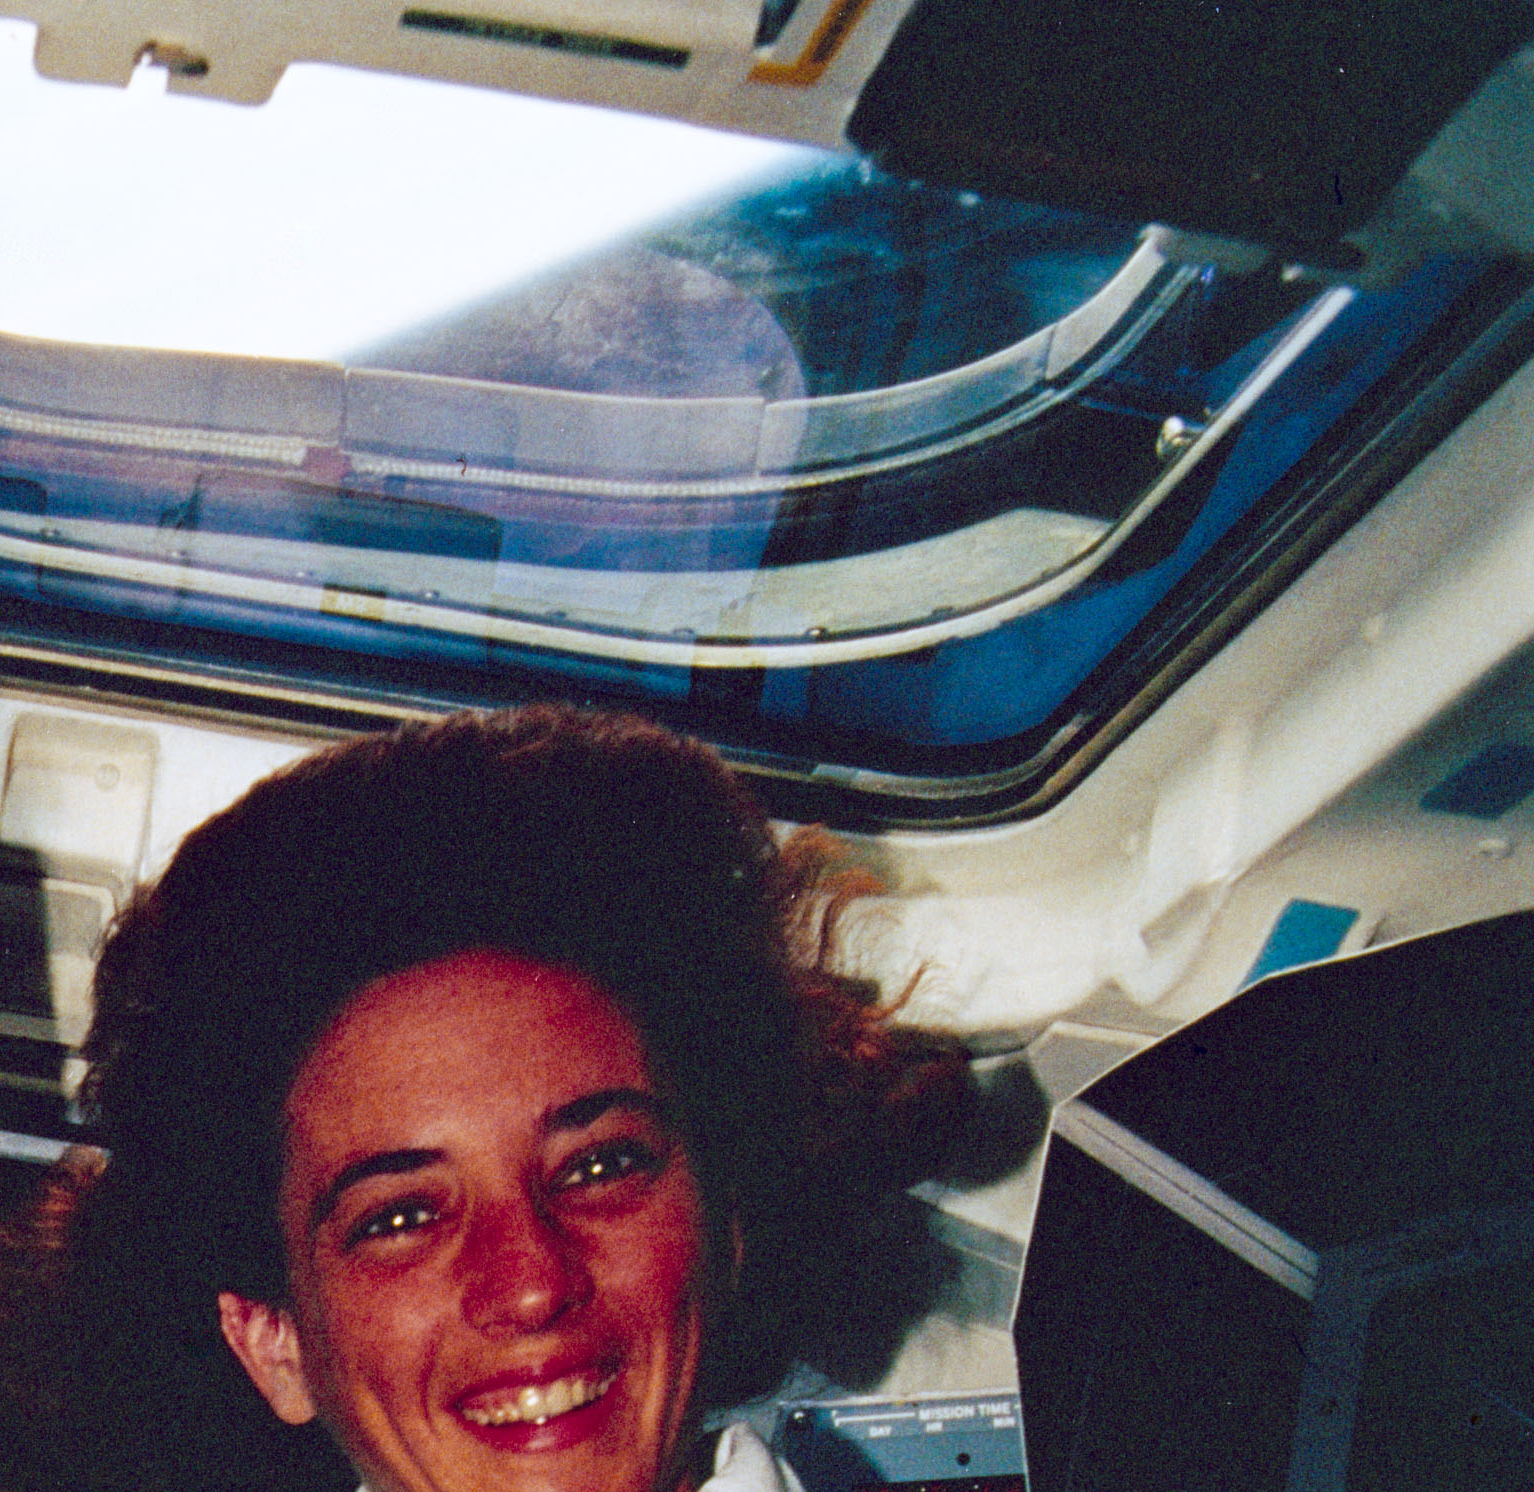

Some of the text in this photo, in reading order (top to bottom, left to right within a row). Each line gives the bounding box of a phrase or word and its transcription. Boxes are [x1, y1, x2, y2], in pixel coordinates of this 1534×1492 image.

[918, 1401, 1012, 1421] MISSION TIME
[868, 1424, 893, 1438] DAY
